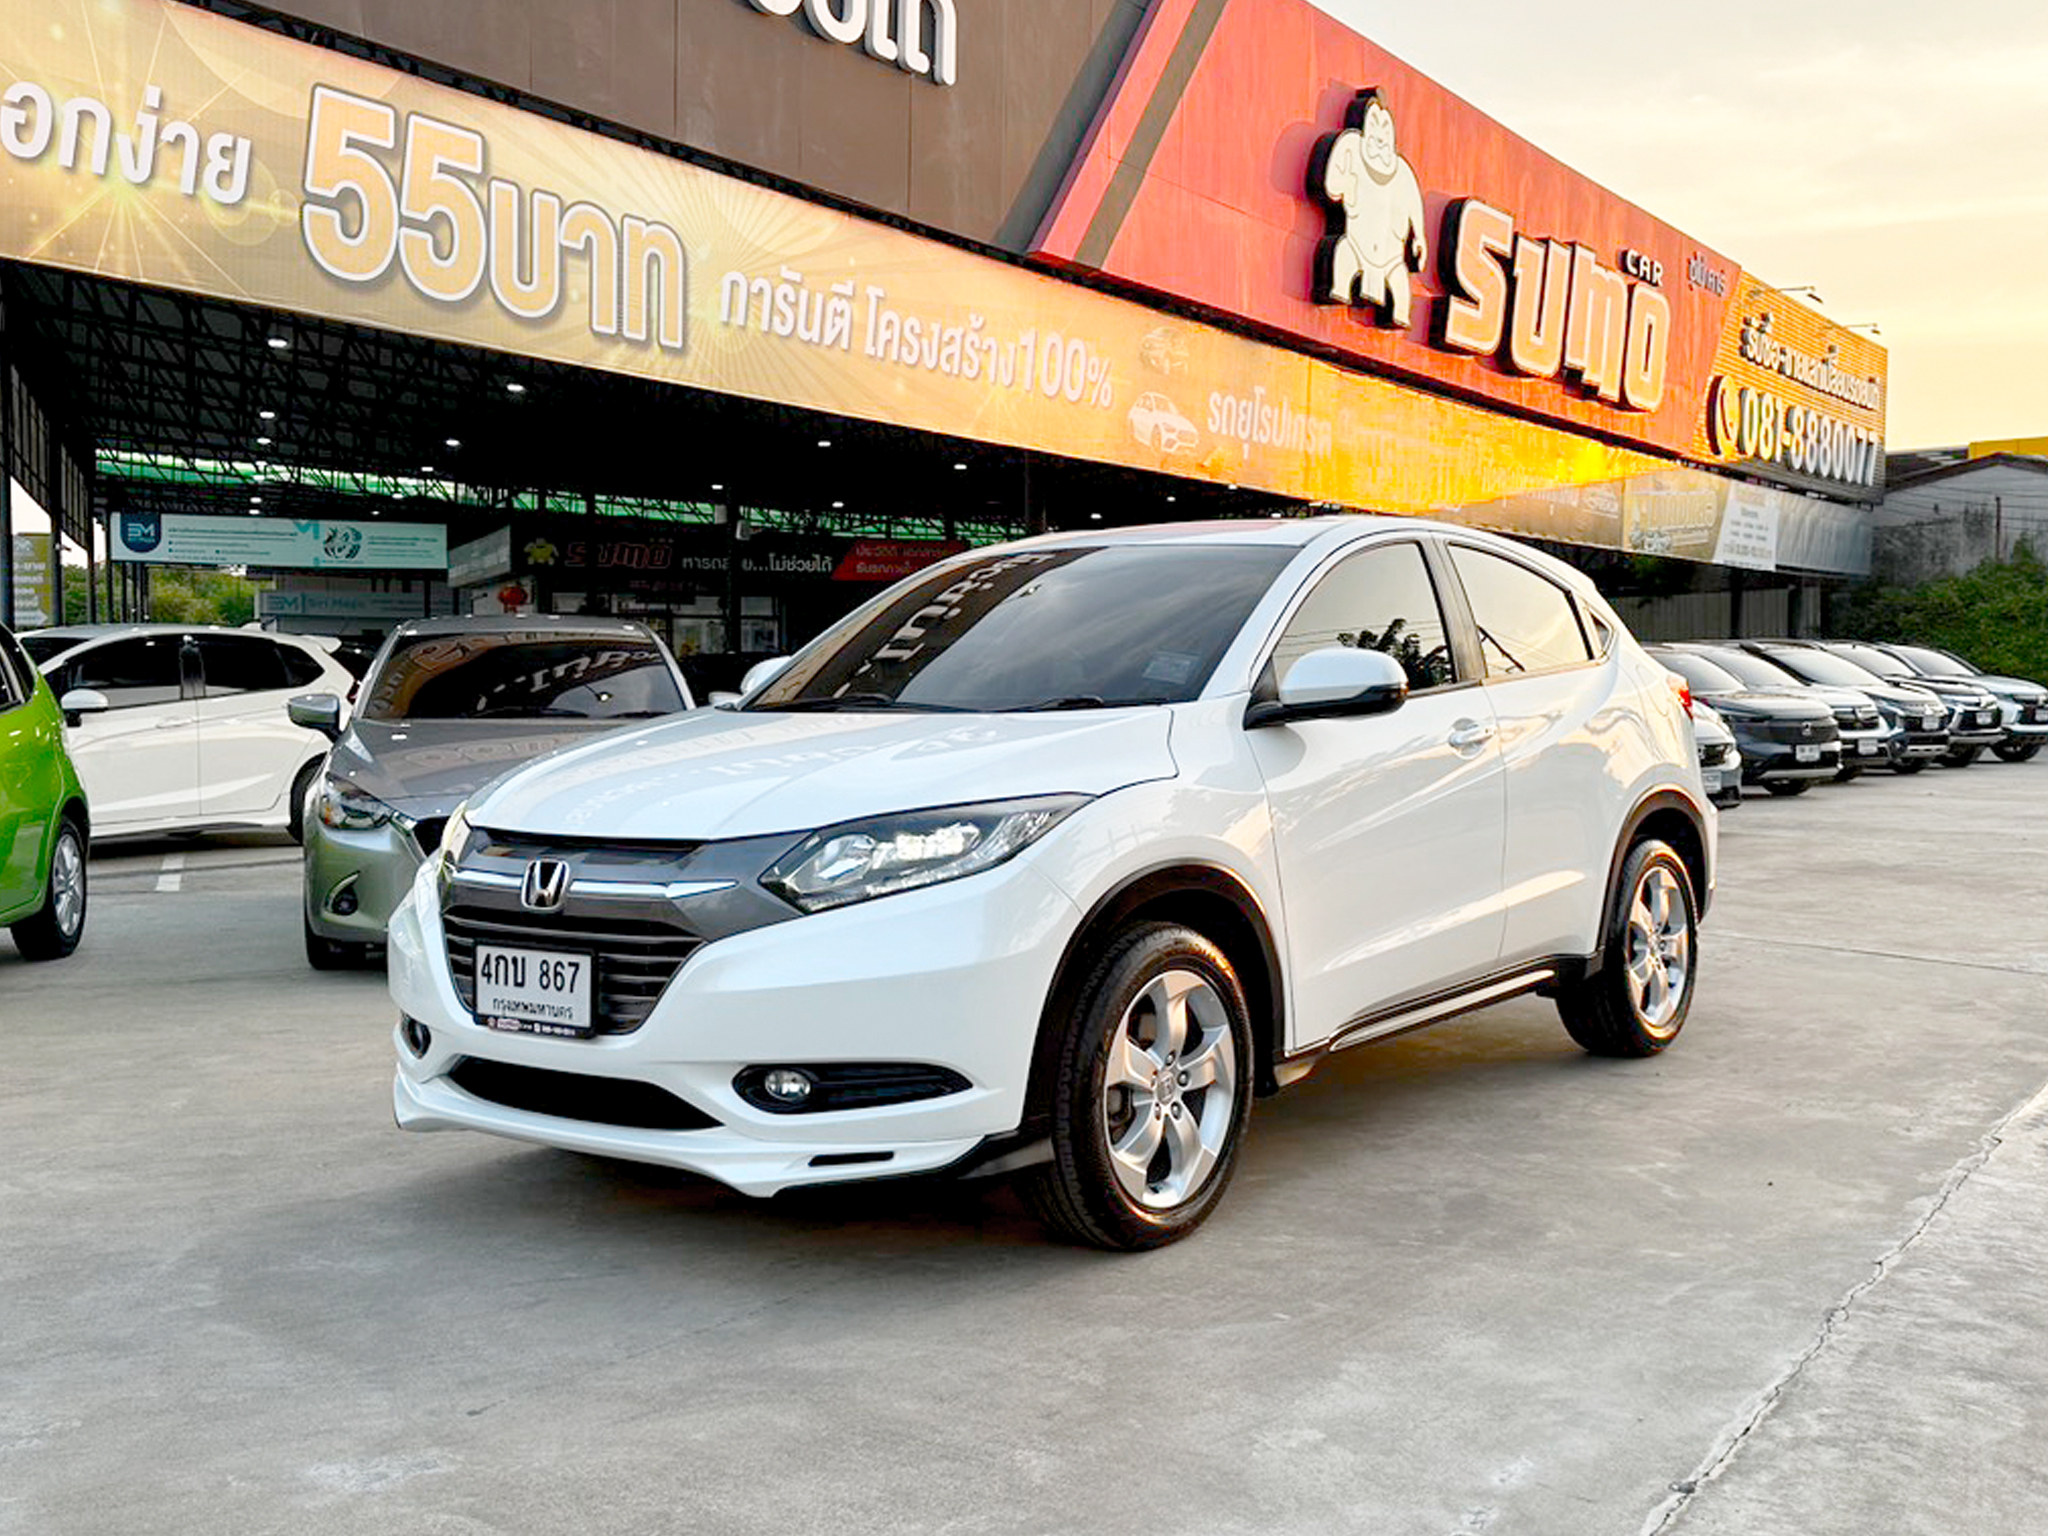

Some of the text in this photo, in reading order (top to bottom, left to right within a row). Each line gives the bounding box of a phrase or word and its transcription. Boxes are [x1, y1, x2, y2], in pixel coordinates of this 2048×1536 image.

[302, 84, 686, 349] 55บาท
[719, 264, 856, 352] การันตี
[1624, 248, 1663, 288] CAR
[1743, 386, 1879, 488] 081-8880077
[481, 953, 580, 993] 4กบ 867
